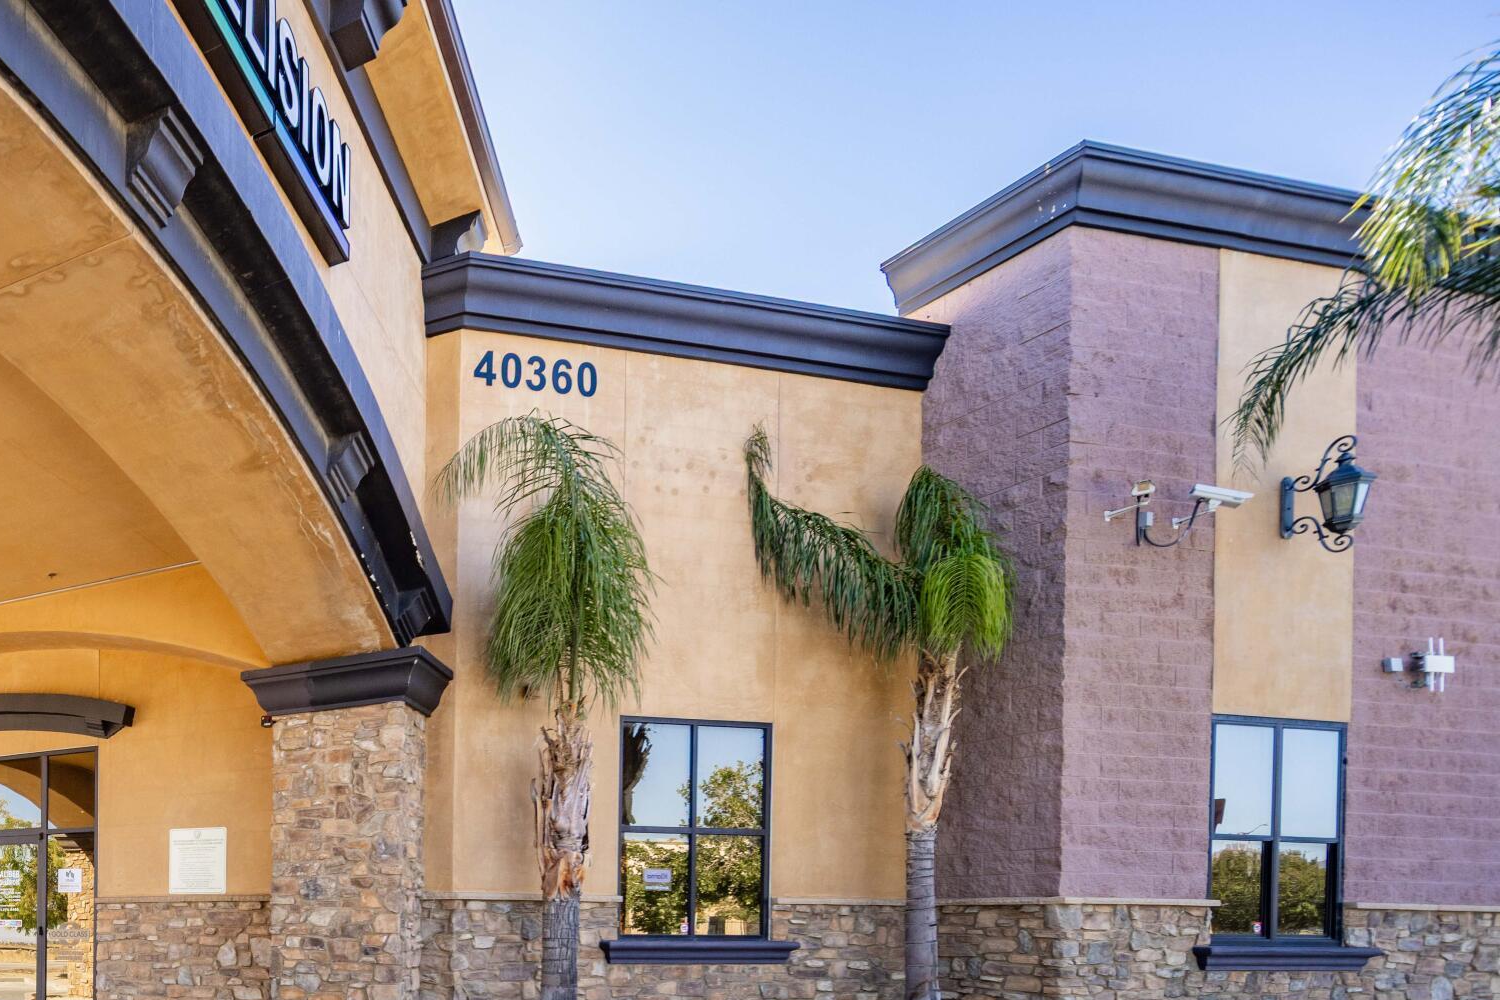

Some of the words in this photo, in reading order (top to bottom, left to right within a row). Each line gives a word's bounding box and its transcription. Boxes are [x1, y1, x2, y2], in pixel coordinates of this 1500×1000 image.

[473, 350, 598, 398] 40360
[51, 930, 69, 938] GOLD
[69, 930, 88, 938] CLASS
